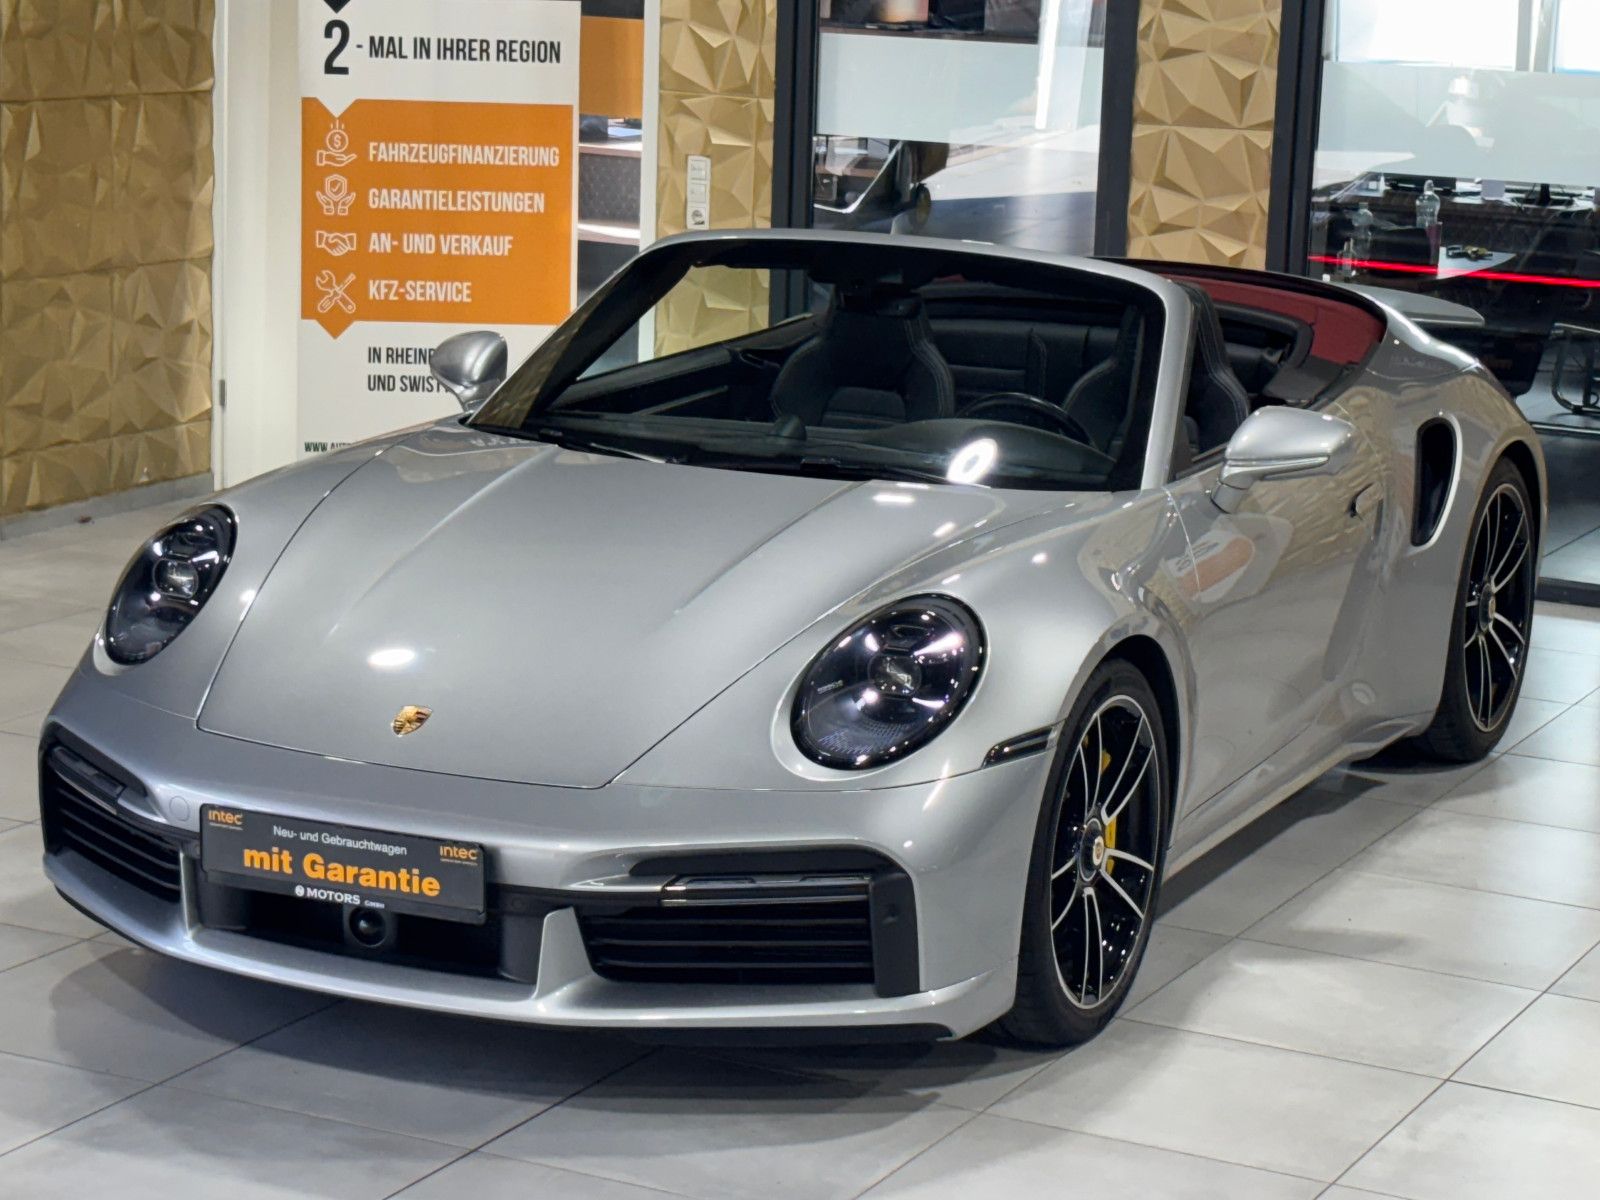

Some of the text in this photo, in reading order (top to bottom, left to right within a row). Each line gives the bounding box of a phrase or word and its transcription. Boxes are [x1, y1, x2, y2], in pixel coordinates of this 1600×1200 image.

[323, 19, 350, 75] 2
[369, 35, 408, 59] MAL
[413, 37, 431, 60] IN
[437, 38, 490, 61] IHRER
[496, 39, 561, 63] REGION
[369, 142, 560, 167] FAHRZEUGFINANZIERUNG
[368, 188, 545, 213] GARANTIELEISTUNGEN
[369, 232, 513, 256] AN- UND VERKAUF
[368, 280, 472, 302] KFZ-SERVICE
[368, 346, 381, 364] IN
[368, 374, 396, 392] UND
[273, 825, 408, 856] Neu- und Gebrauchtwagen
[243, 846, 441, 897] mit Garantie
[306, 887, 361, 905] MOTORS
